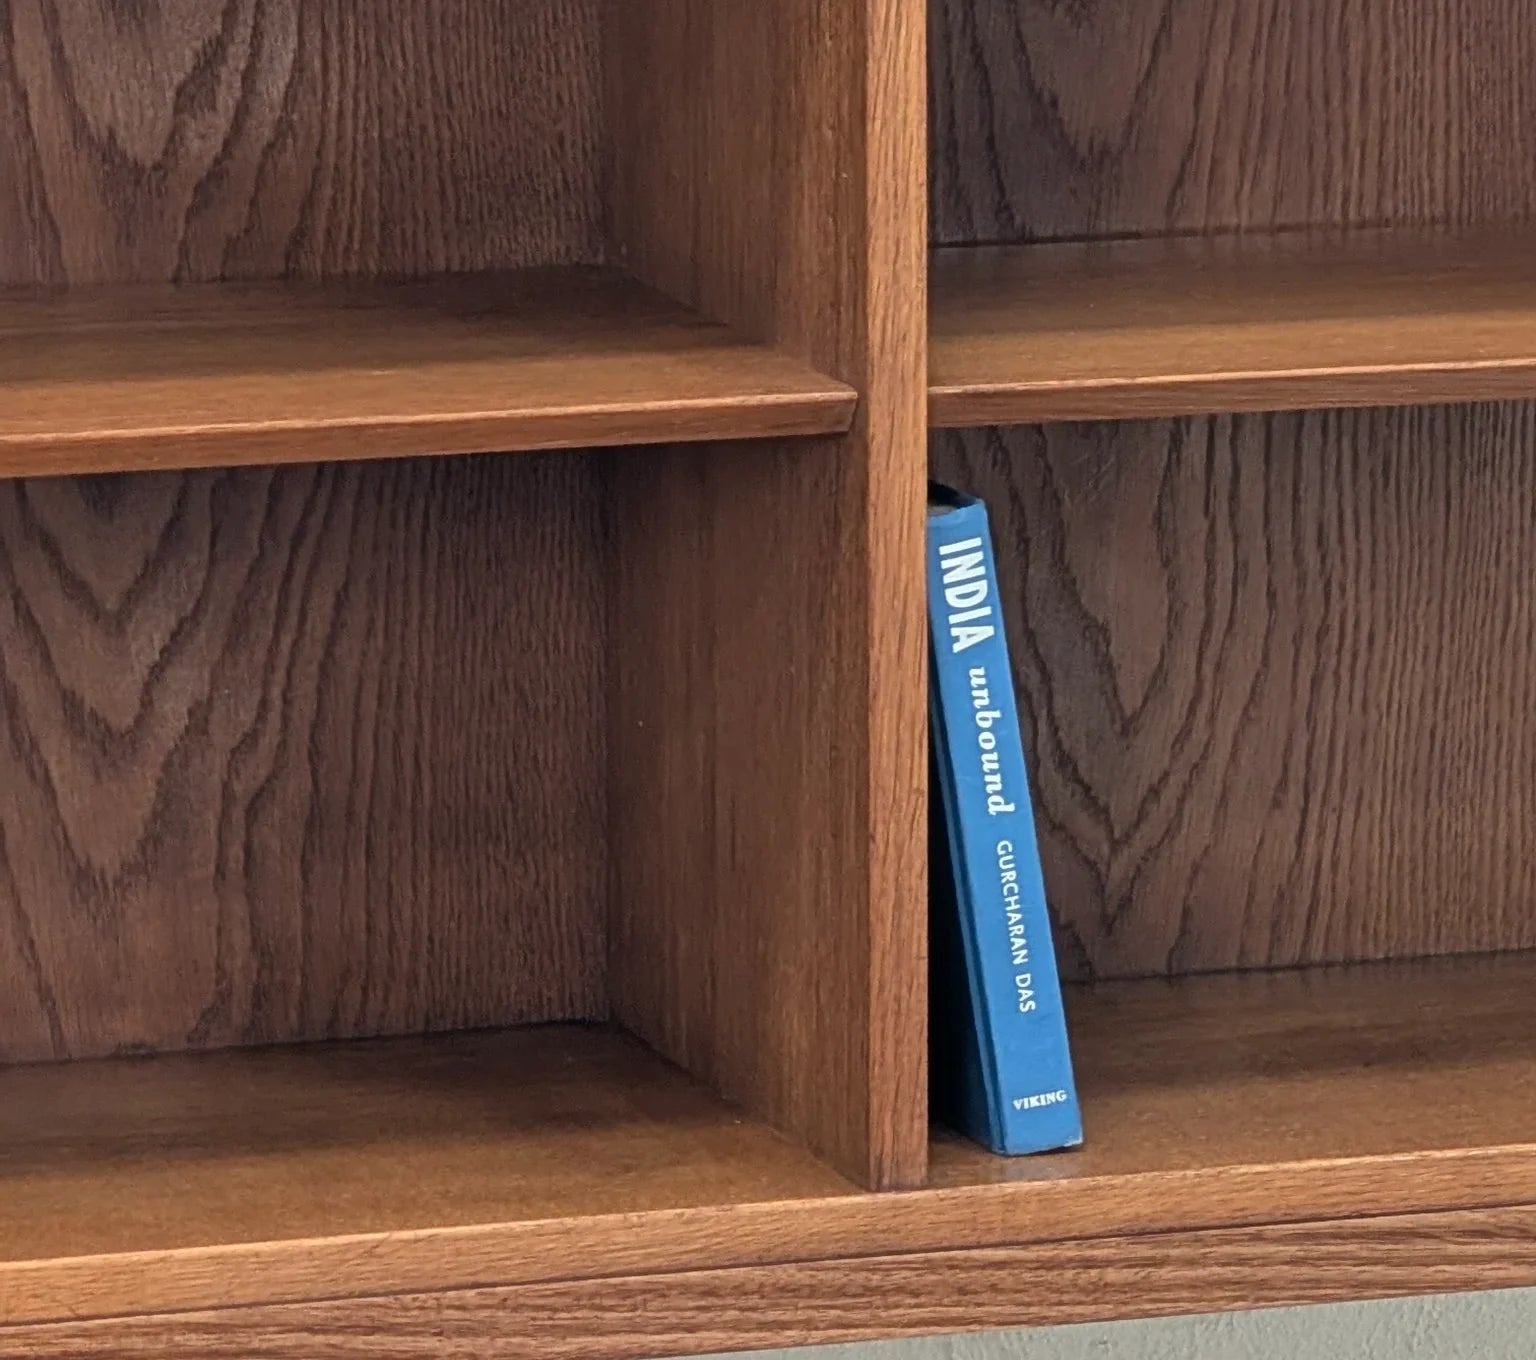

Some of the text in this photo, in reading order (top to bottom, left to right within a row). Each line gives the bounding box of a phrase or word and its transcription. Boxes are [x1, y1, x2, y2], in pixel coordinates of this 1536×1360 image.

[939, 537, 1016, 815] INDIA unbound
[996, 840, 1036, 1013] GURCHARAN DAS
[1013, 1090, 1067, 1110] VIKING
